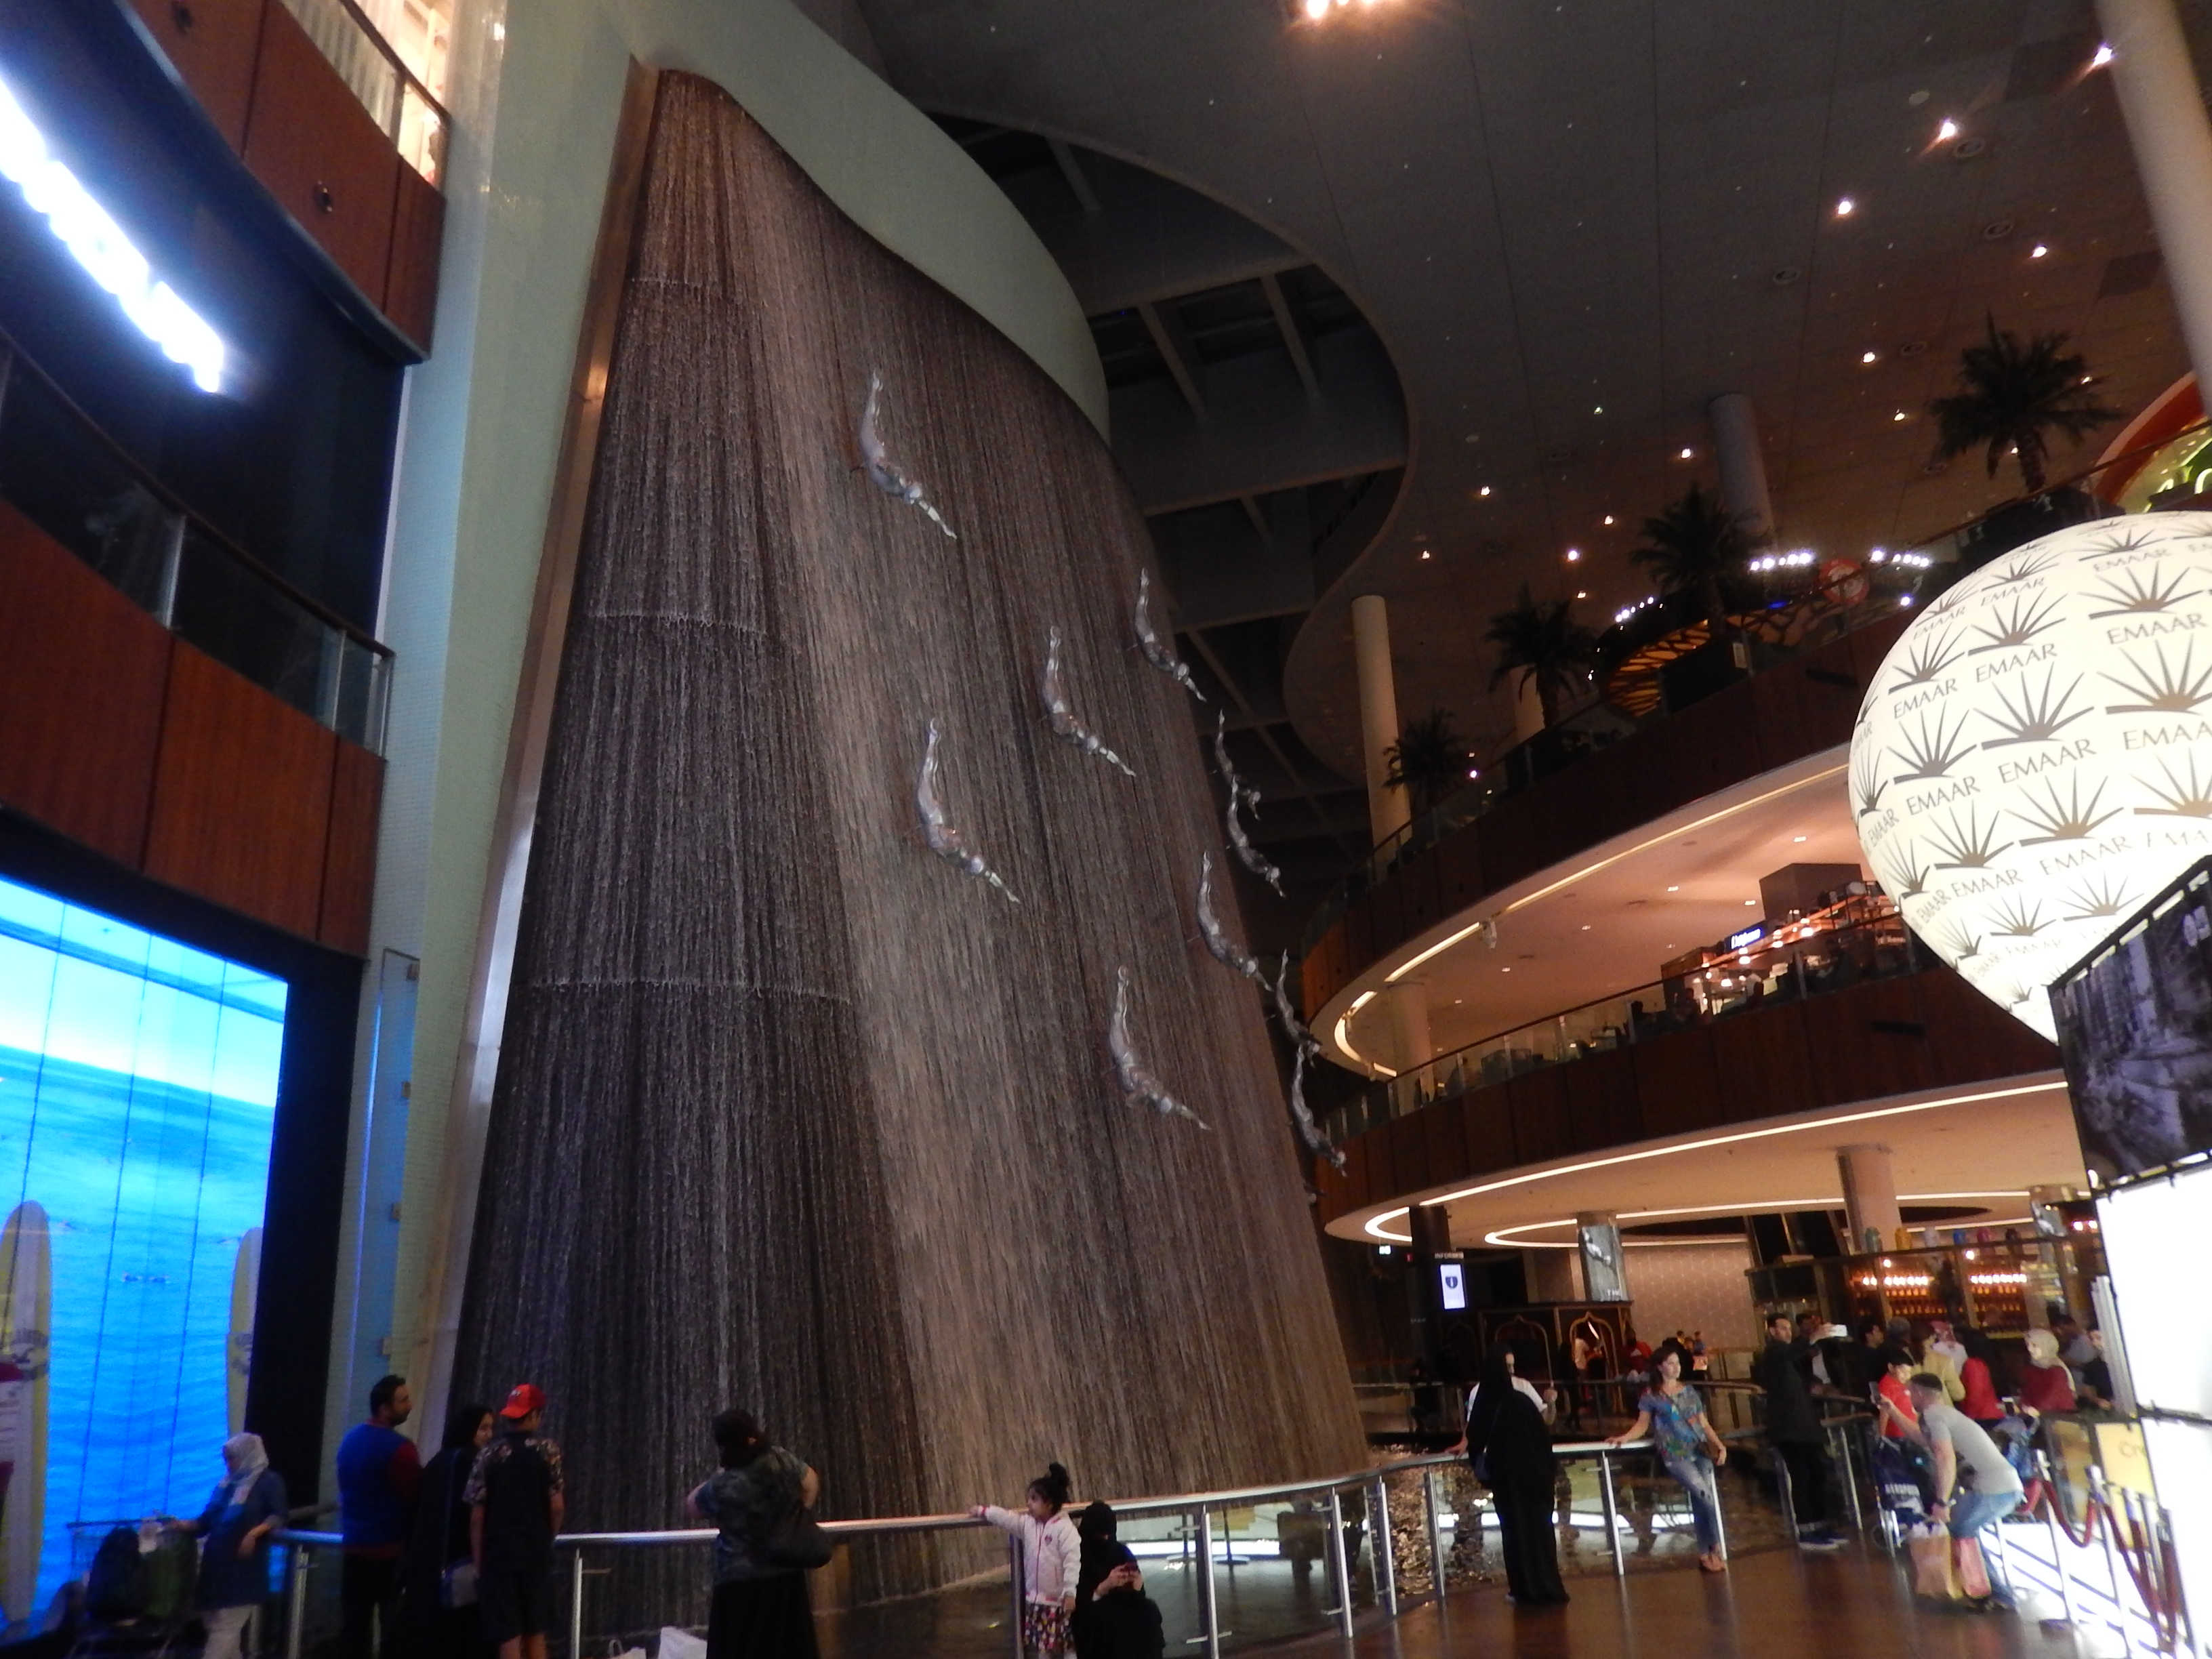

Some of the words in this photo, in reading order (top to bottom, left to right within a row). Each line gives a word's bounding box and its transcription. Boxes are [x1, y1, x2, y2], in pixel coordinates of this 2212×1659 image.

[2093, 548, 2171, 572] EMAAR
[1981, 577, 2045, 607] EMAAR
[1913, 607, 1966, 640] EMAAR
[2107, 613, 2208, 644] EMAAR
[1975, 643, 2057, 683] EMAAR
[1893, 678, 1958, 719] EMAAR
[1998, 739, 2097, 783] EMAAR
[1906, 775, 1981, 815] EMAAR
[1868, 808, 1900, 847] EMAAR
[2039, 836, 2132, 876] EMAAR
[1951, 869, 2024, 897] EMAAR
[1917, 889, 1951, 924] EMAAR
